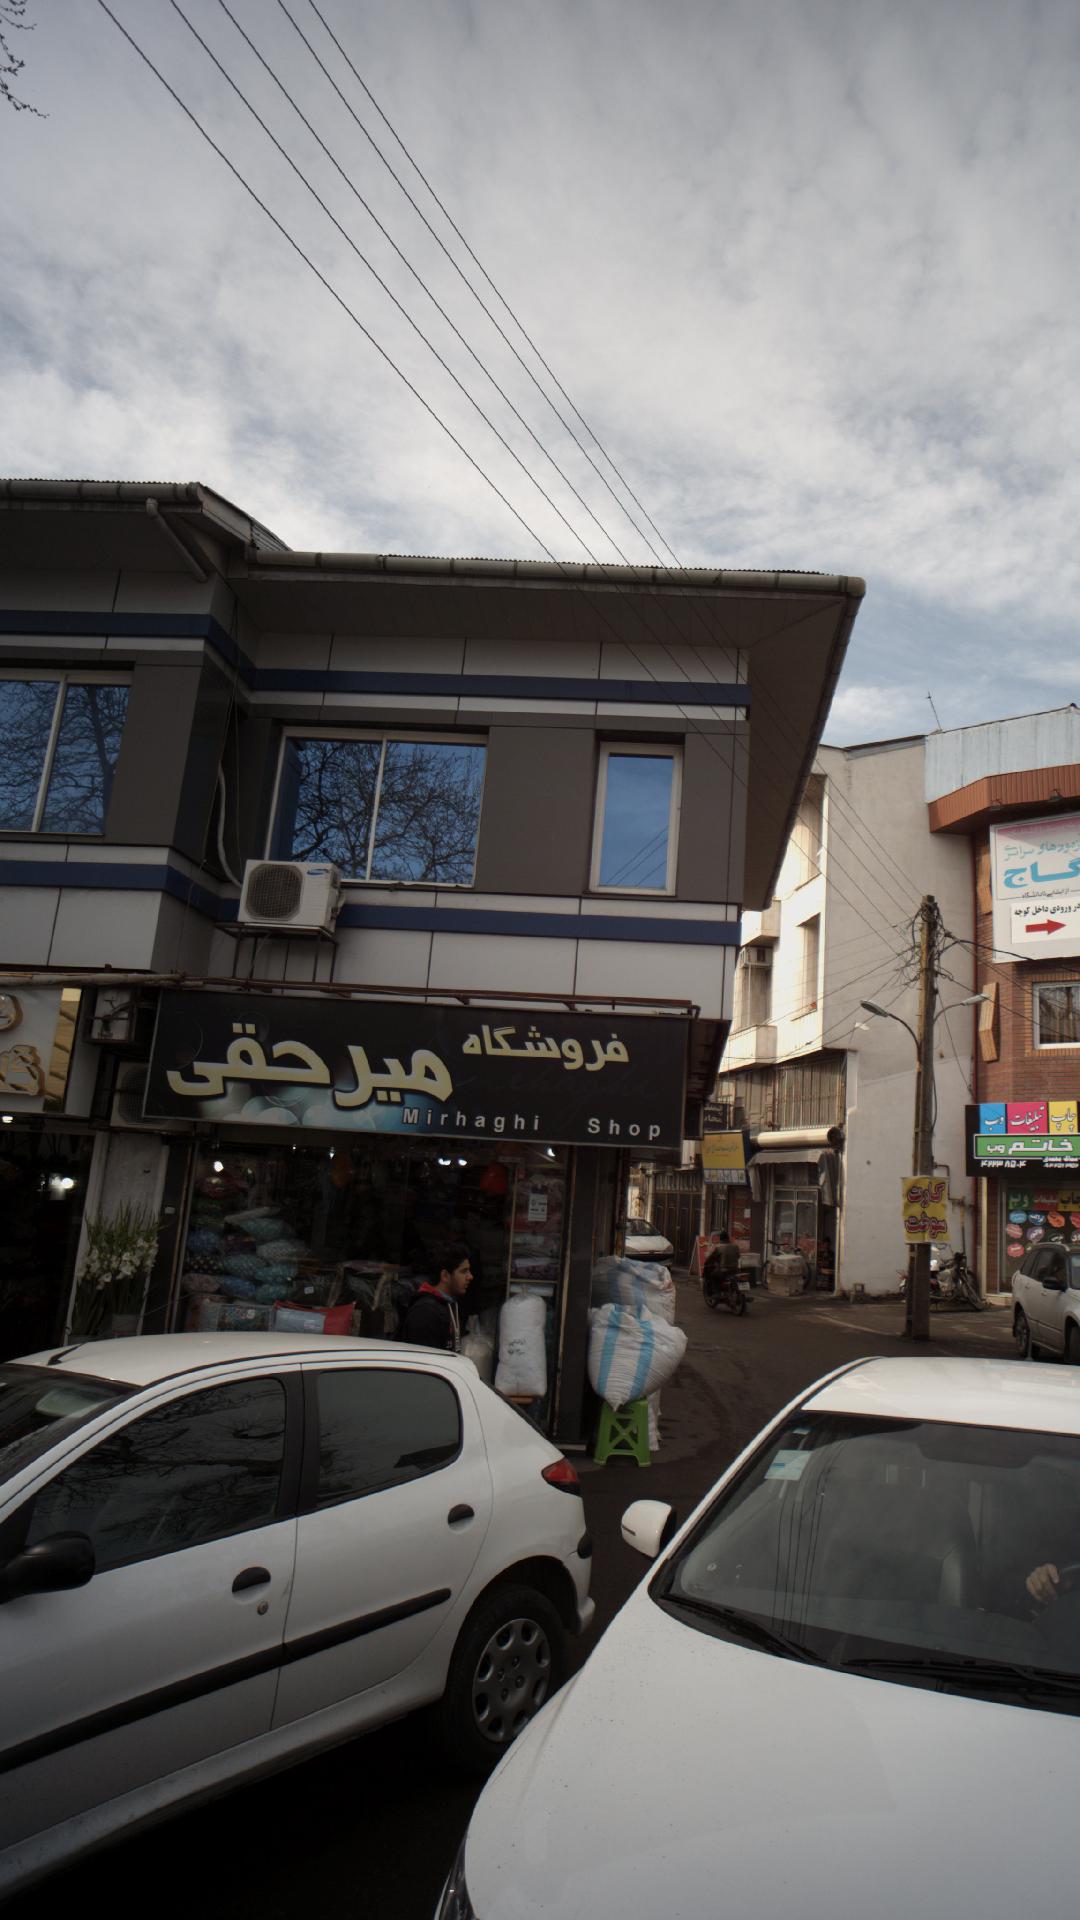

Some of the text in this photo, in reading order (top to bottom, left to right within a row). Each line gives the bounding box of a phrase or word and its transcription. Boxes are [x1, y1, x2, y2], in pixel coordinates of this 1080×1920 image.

[1014, 906, 1031, 917] کوچه
[1031, 905, 1049, 916] داخل
[1050, 905, 1072, 914] ورودی
[165, 1021, 333, 1097] حقی
[460, 1024, 630, 1072] فروشگاه
[332, 1043, 454, 1108] میر
[401, 1106, 663, 1140] Mirhaghi Shop
[984, 1105, 1077, 1132] چاپ تبلیغات وب
[986, 1138, 1074, 1156] خاتم وب
[904, 1210, 948, 1239] سوخت
